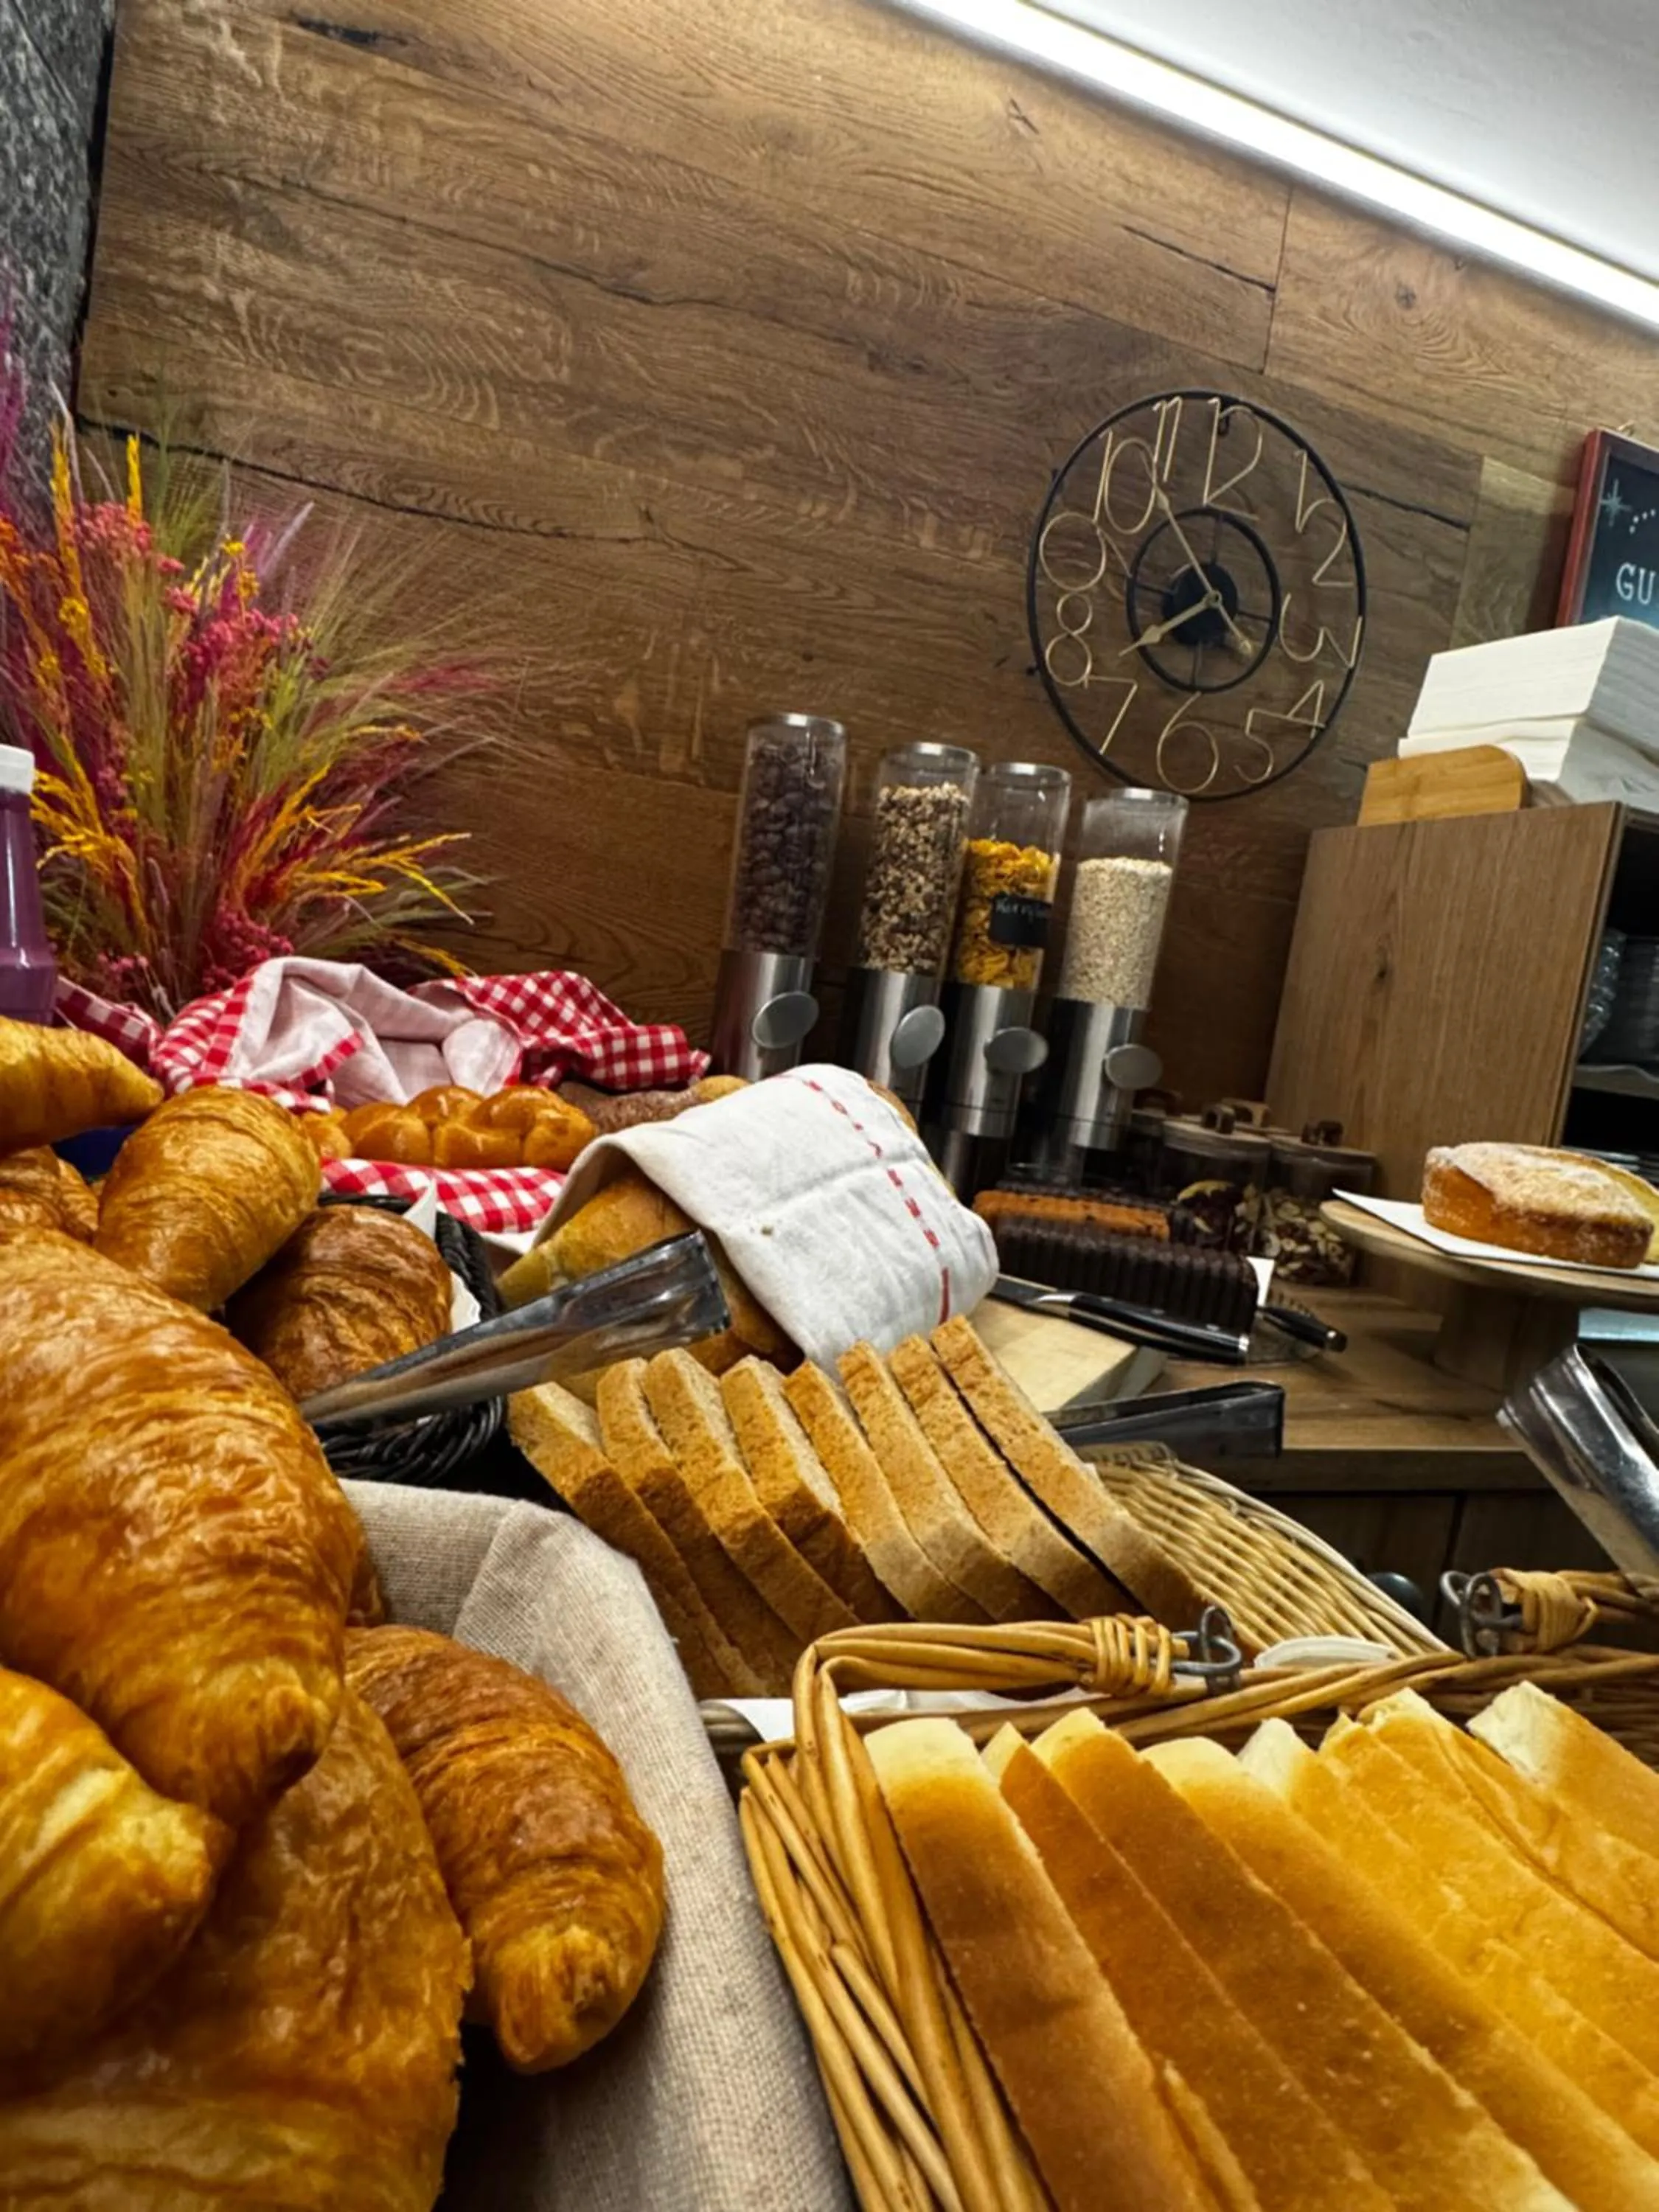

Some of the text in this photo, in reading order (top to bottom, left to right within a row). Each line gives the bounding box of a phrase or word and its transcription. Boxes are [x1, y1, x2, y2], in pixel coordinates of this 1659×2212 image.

[1094, 429, 1159, 534] 10
[1152, 397, 1183, 483] 11
[1203, 397, 1262, 521] 12
[1293, 449, 1309, 532] 1
[1040, 512, 1133, 590] 9
[1296, 498, 1354, 587] 2
[1045, 593, 1093, 687] 8
[1279, 593, 1363, 669] 3
[1084, 674, 1138, 755] 7
[1157, 691, 1219, 795] 6
[1234, 708, 1287, 784] 5
[1286, 679, 1326, 739] 4
